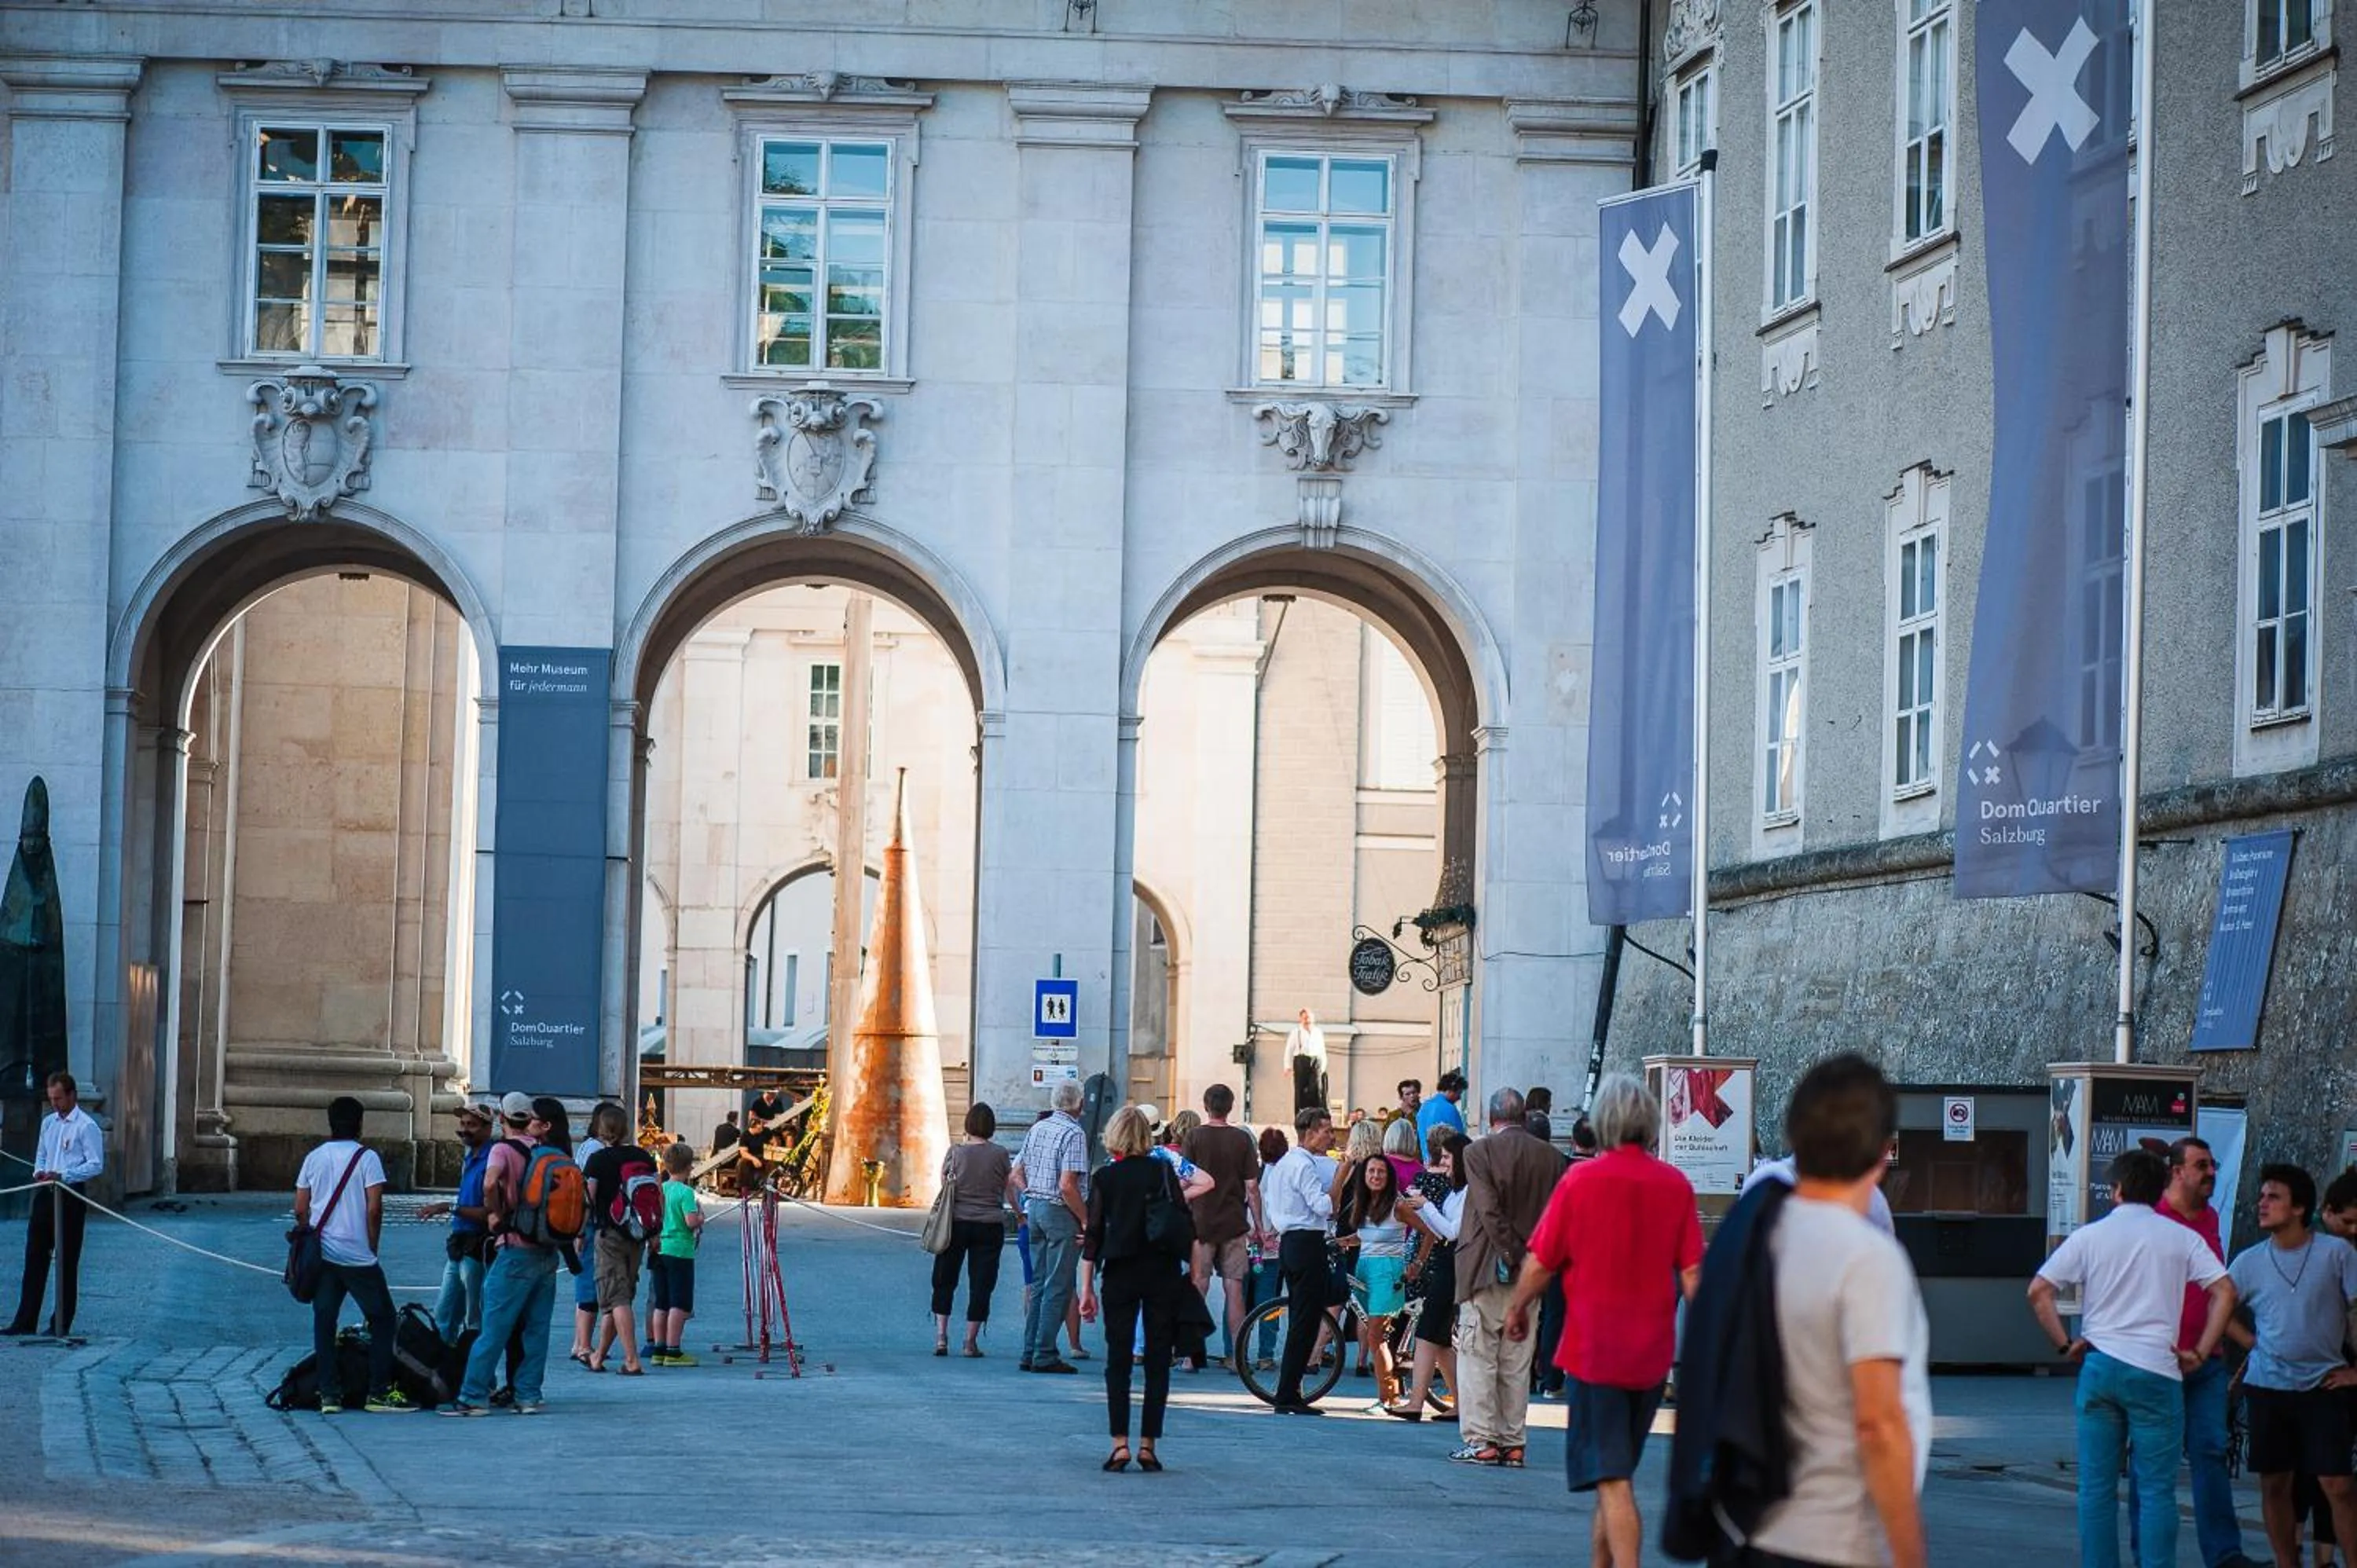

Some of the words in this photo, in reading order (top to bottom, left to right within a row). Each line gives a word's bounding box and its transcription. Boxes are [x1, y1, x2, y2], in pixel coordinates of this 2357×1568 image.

[510, 662, 538, 674] Mehr
[541, 664, 588, 675] Museum
[510, 680, 527, 691] für
[527, 680, 588, 694] jedermann
[1981, 794, 2101, 819] DomQuartier
[1980, 826, 2045, 846] Salzburg
[511, 1022, 585, 1034] DomQuartier
[511, 1035, 554, 1049] Salzburg
